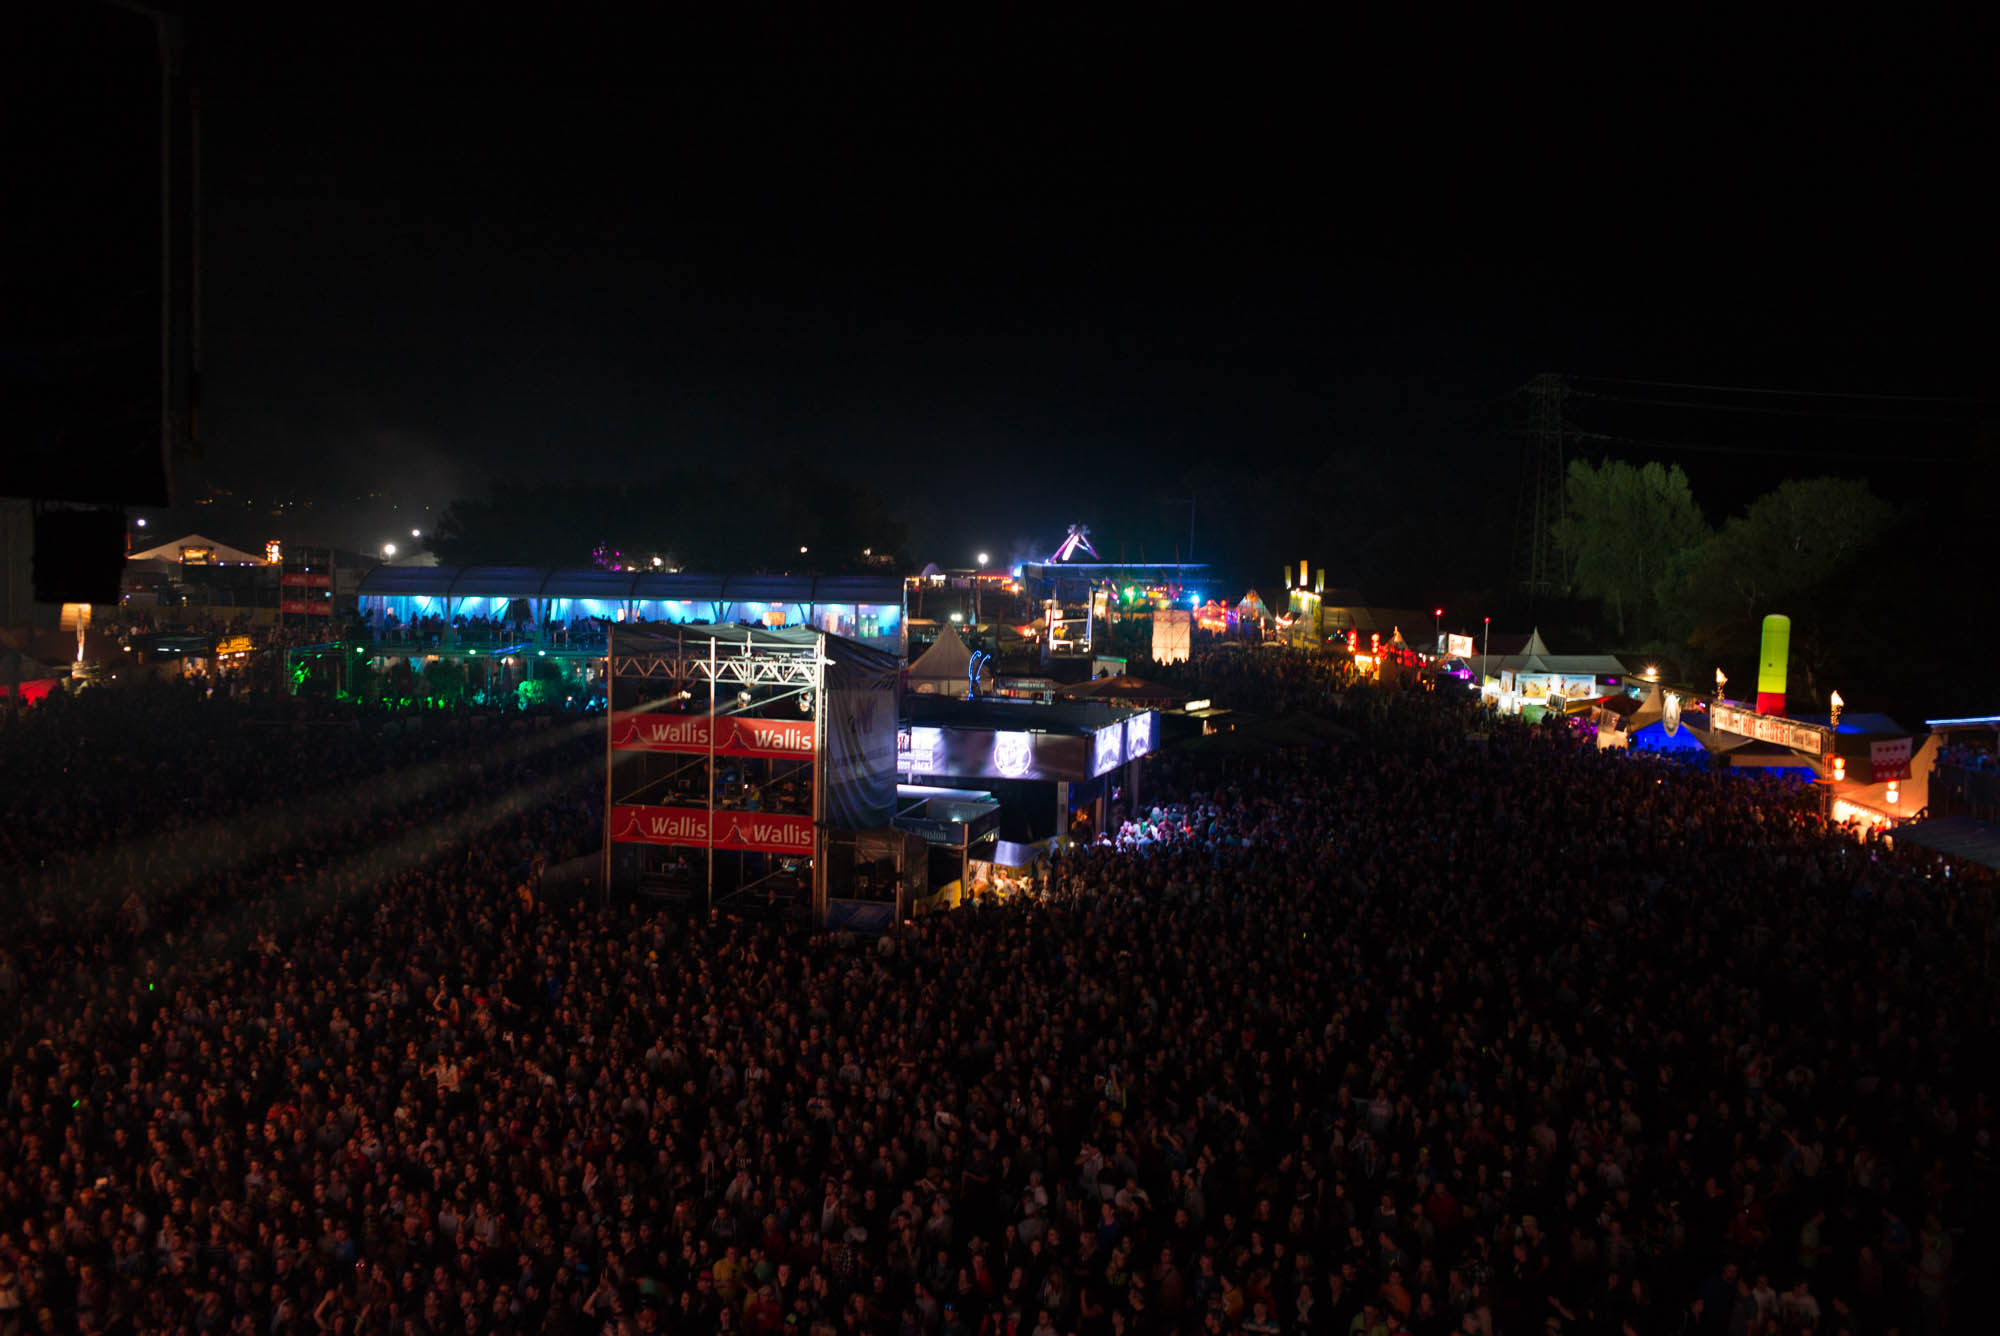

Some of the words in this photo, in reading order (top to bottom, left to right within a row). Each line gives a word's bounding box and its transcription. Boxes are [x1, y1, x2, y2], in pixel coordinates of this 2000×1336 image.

[651, 723, 709, 743] Wallis
[754, 728, 812, 751] Wallis
[651, 816, 707, 838] Wallis
[753, 823, 811, 845] Wallis
